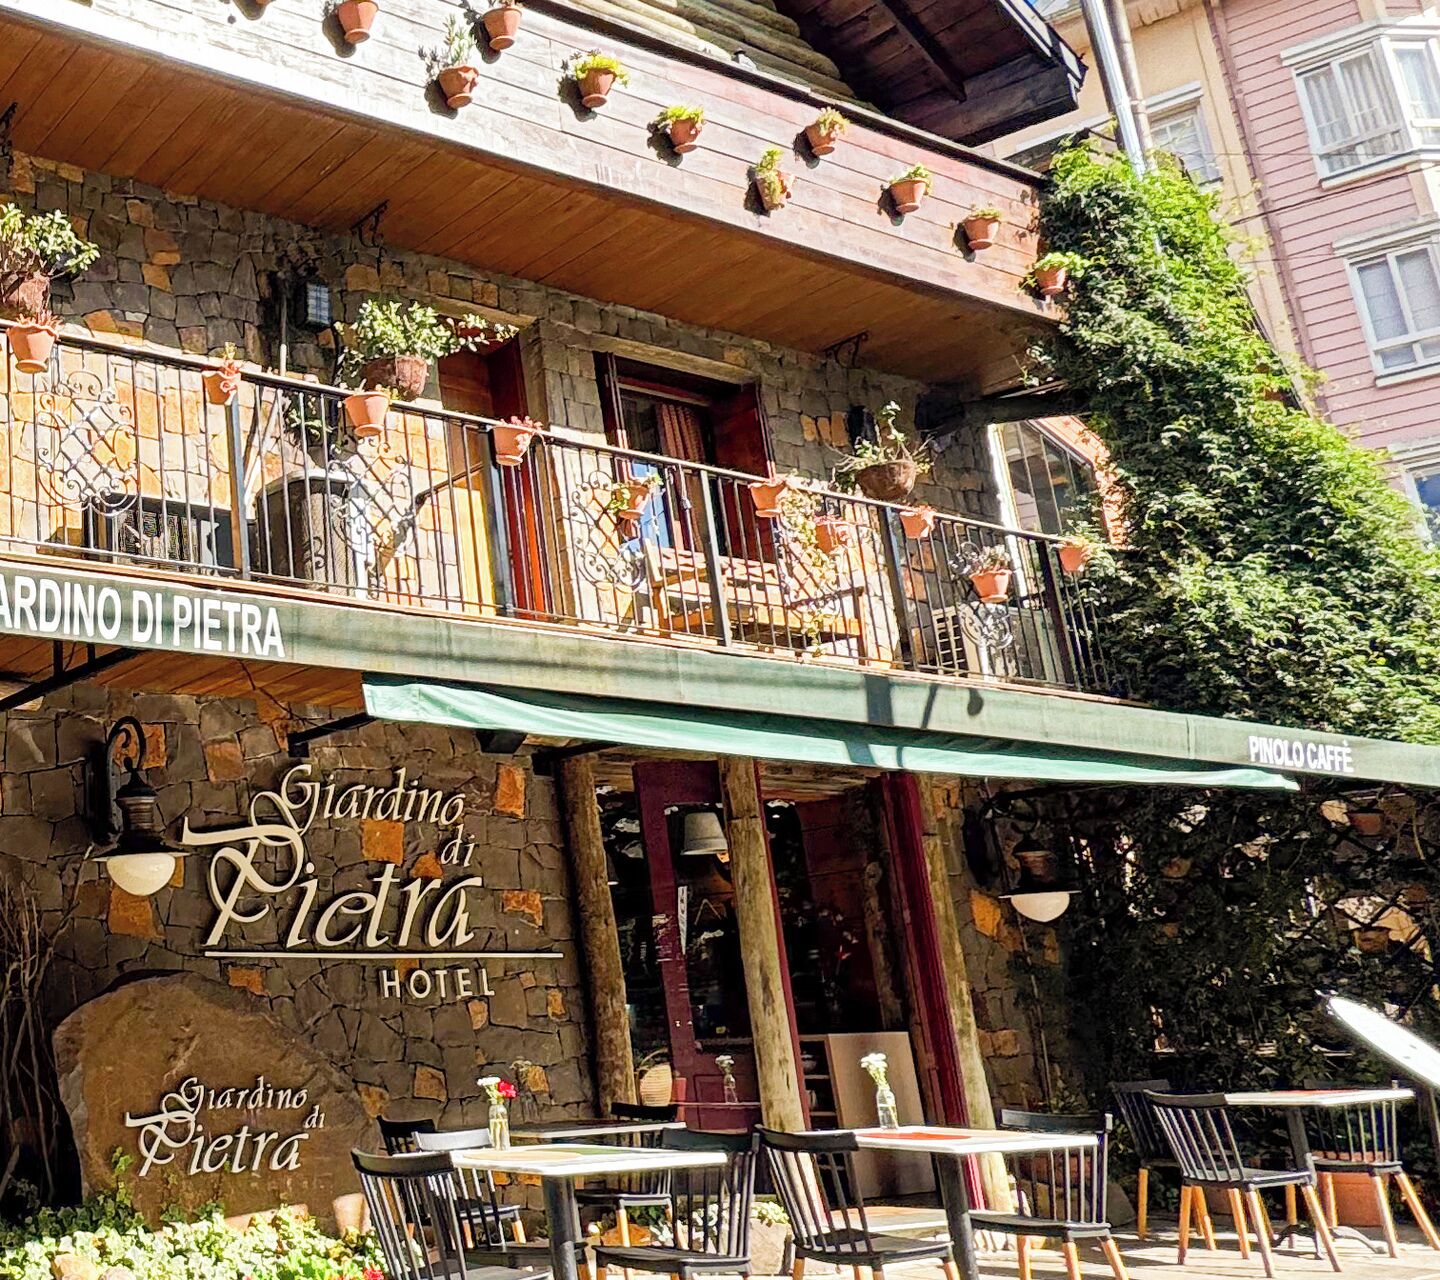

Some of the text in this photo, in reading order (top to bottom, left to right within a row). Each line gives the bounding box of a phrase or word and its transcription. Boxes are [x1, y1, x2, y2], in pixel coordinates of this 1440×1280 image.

[132, 589, 162, 645] DI
[173, 595, 286, 658] PIETRA
[1248, 735, 1355, 773] PINOLO CAFFÈ
[280, 763, 466, 835] Giardino
[440, 823, 477, 868] di
[180, 790, 483, 950] Pietra
[381, 967, 496, 1000] HOTEL
[177, 1075, 309, 1117] Giardino
[304, 1104, 326, 1130] di
[124, 1091, 311, 1178] Pietra
